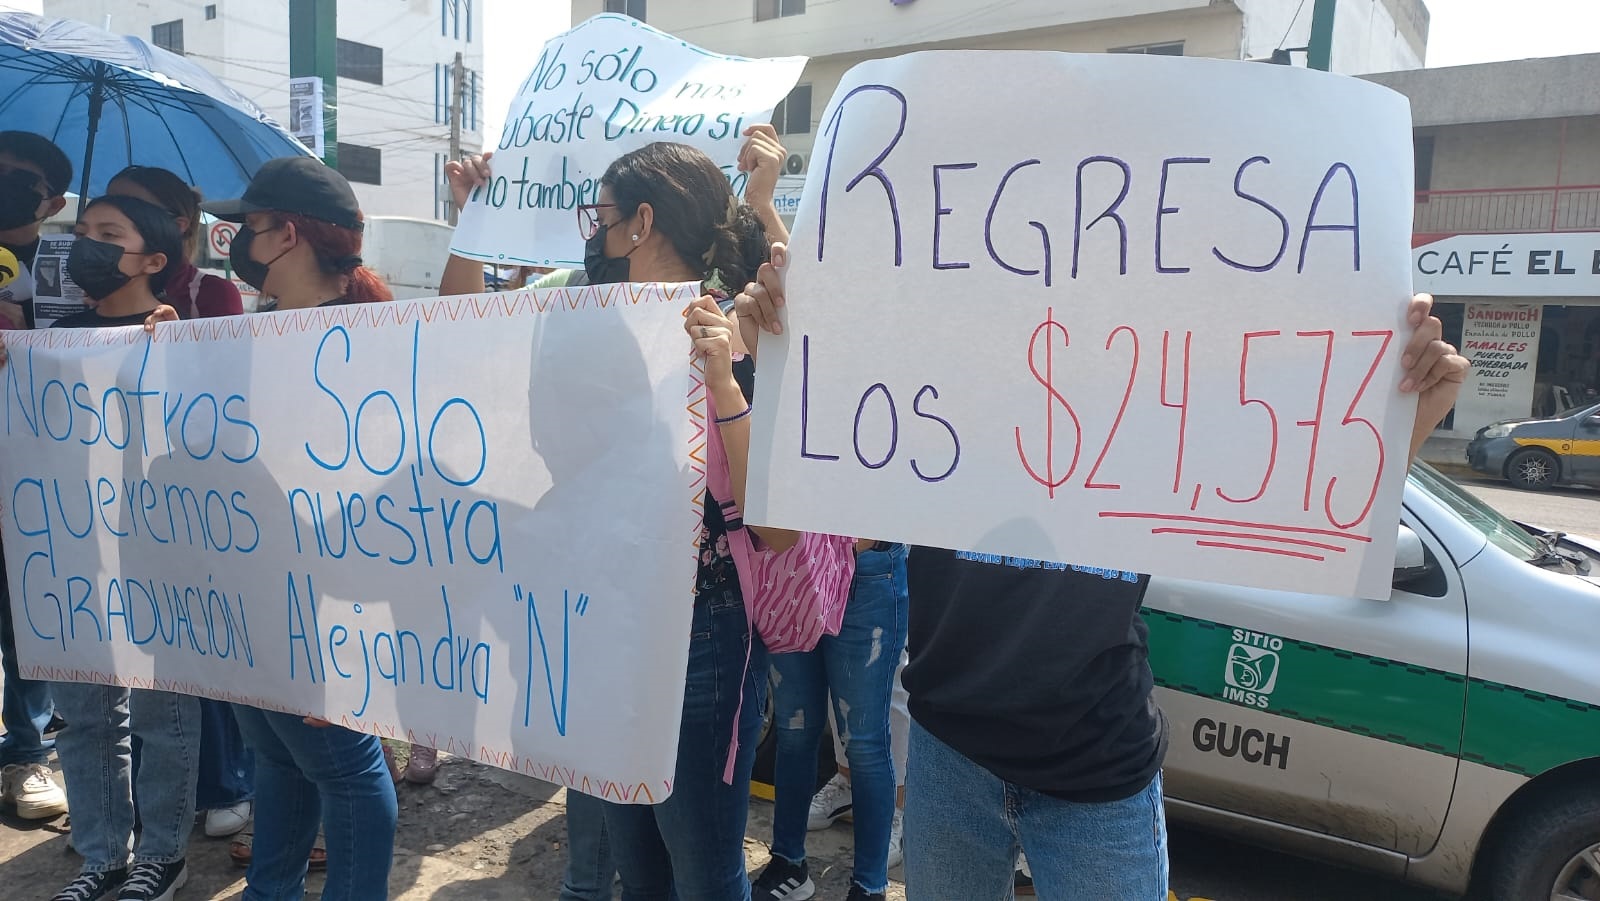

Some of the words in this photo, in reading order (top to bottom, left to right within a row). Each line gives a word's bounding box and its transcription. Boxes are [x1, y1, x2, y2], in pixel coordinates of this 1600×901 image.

[521, 43, 566, 96] No
[577, 46, 657, 92] sólo
[604, 97, 705, 141] Dinero
[708, 112, 744, 140] si
[818, 85, 1361, 286] REGRESA
[1417, 243, 1513, 275] CAFÉ
[1528, 250, 1576, 275] EL
[1467, 306, 1539, 321] SANDWICH
[1465, 340, 1528, 352] TAMALES
[1471, 359, 1529, 370] ESHEBRADA
[1473, 351, 1514, 360] PUERCO
[1476, 369, 1509, 378] POLLO
[6, 335, 260, 463] Nosotros
[305, 325, 486, 487] Solo
[799, 334, 961, 482] LOS
[1015, 306, 1394, 529] $24,573
[12, 477, 260, 577] queremos
[288, 464, 504, 574] nuestra
[23, 551, 254, 668] GRADUACIÓN
[287, 571, 491, 717] Alejandra
[513, 584, 589, 737] "N"
[1231, 628, 1284, 651] SITIO
[1222, 686, 1269, 708] IMSS
[1192, 718, 1291, 770] GUCH
